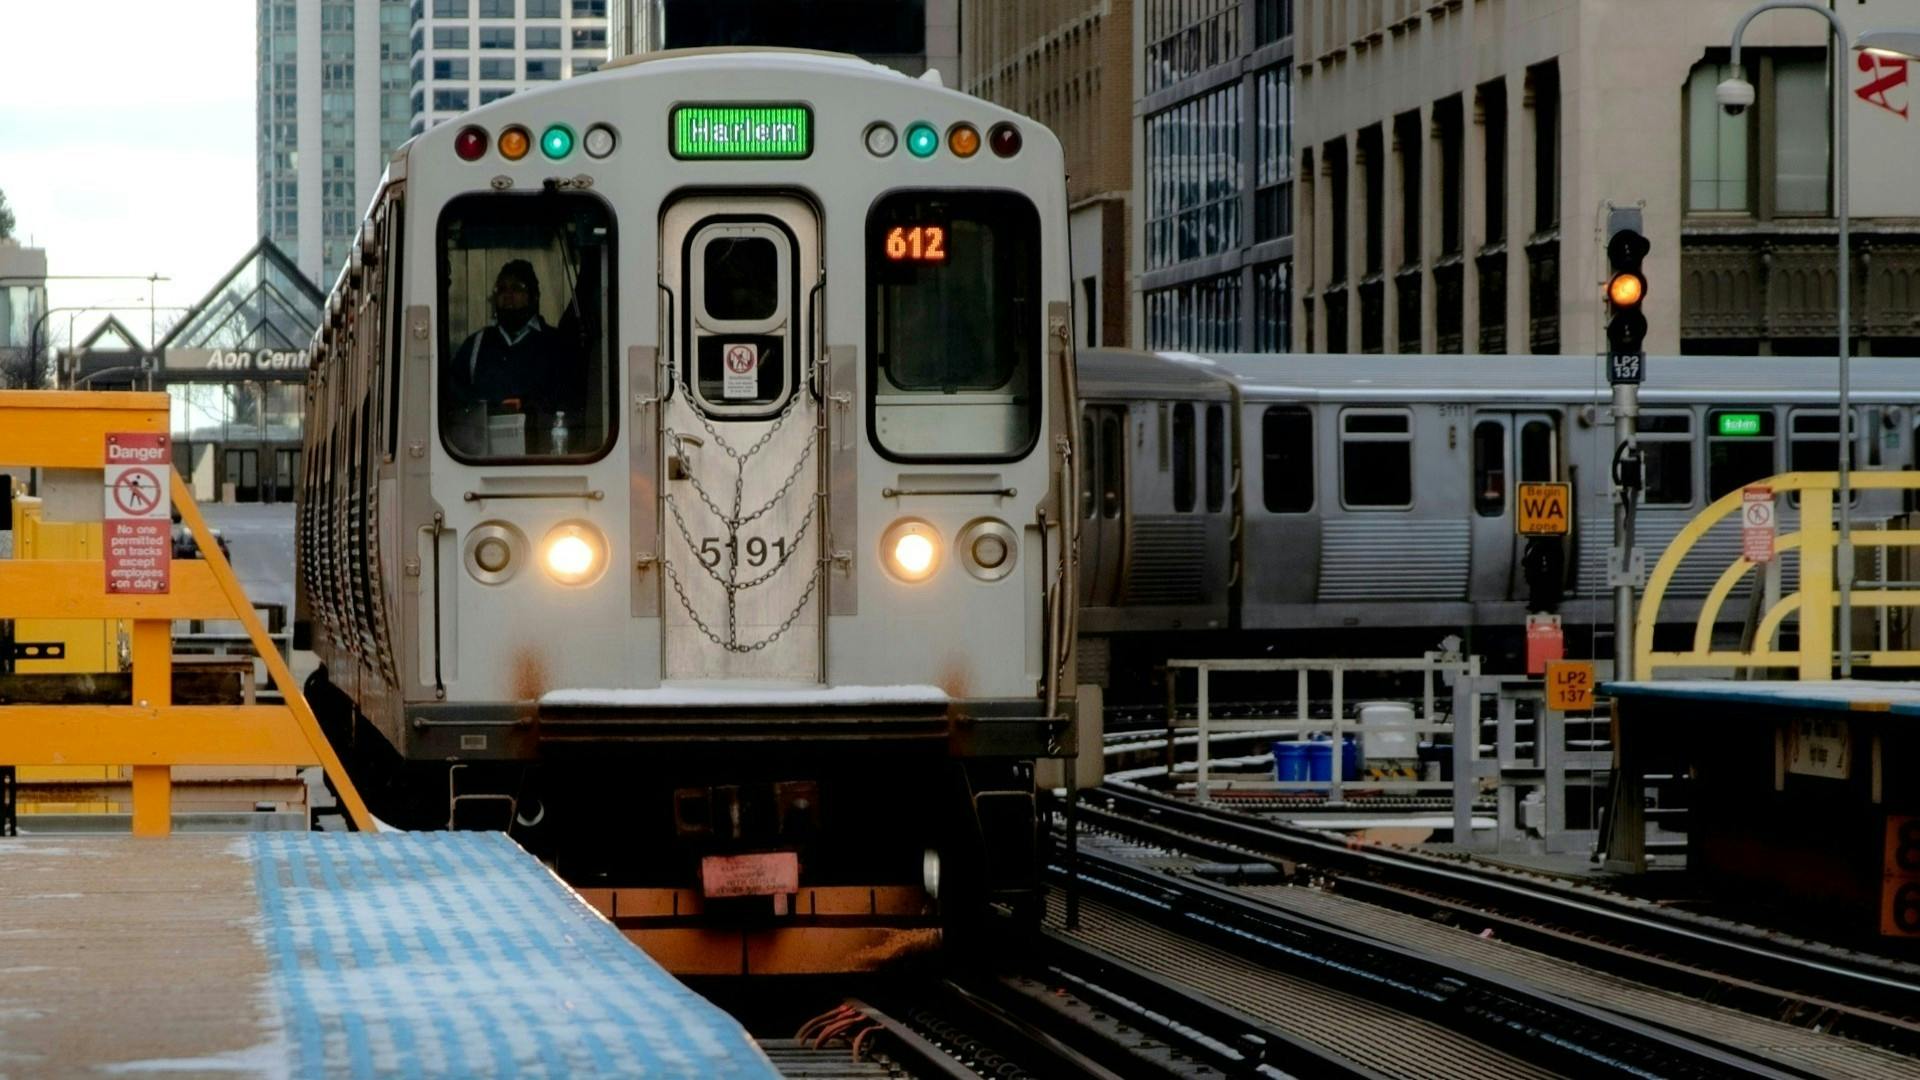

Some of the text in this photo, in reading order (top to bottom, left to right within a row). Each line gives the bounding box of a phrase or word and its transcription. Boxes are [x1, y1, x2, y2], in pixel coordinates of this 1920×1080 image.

[691, 118, 796, 141] Harlem
[887, 226, 945, 258] 612
[206, 348, 311, 369] Aon Cent
[1614, 355, 1639, 367] LP2
[1615, 367, 1639, 378] 137
[109, 445, 165, 461] Danger
[1524, 499, 1564, 518] WA
[117, 525, 157, 534] No one
[111, 536, 164, 547] permitted
[112, 547, 162, 556] on tracks
[701, 536, 785, 567] 5191
[119, 558, 155, 568] except
[111, 568, 163, 579] employees
[116, 579, 159, 590] on duty
[1558, 671, 1586, 685] LP2
[1560, 689, 1585, 703] 137
